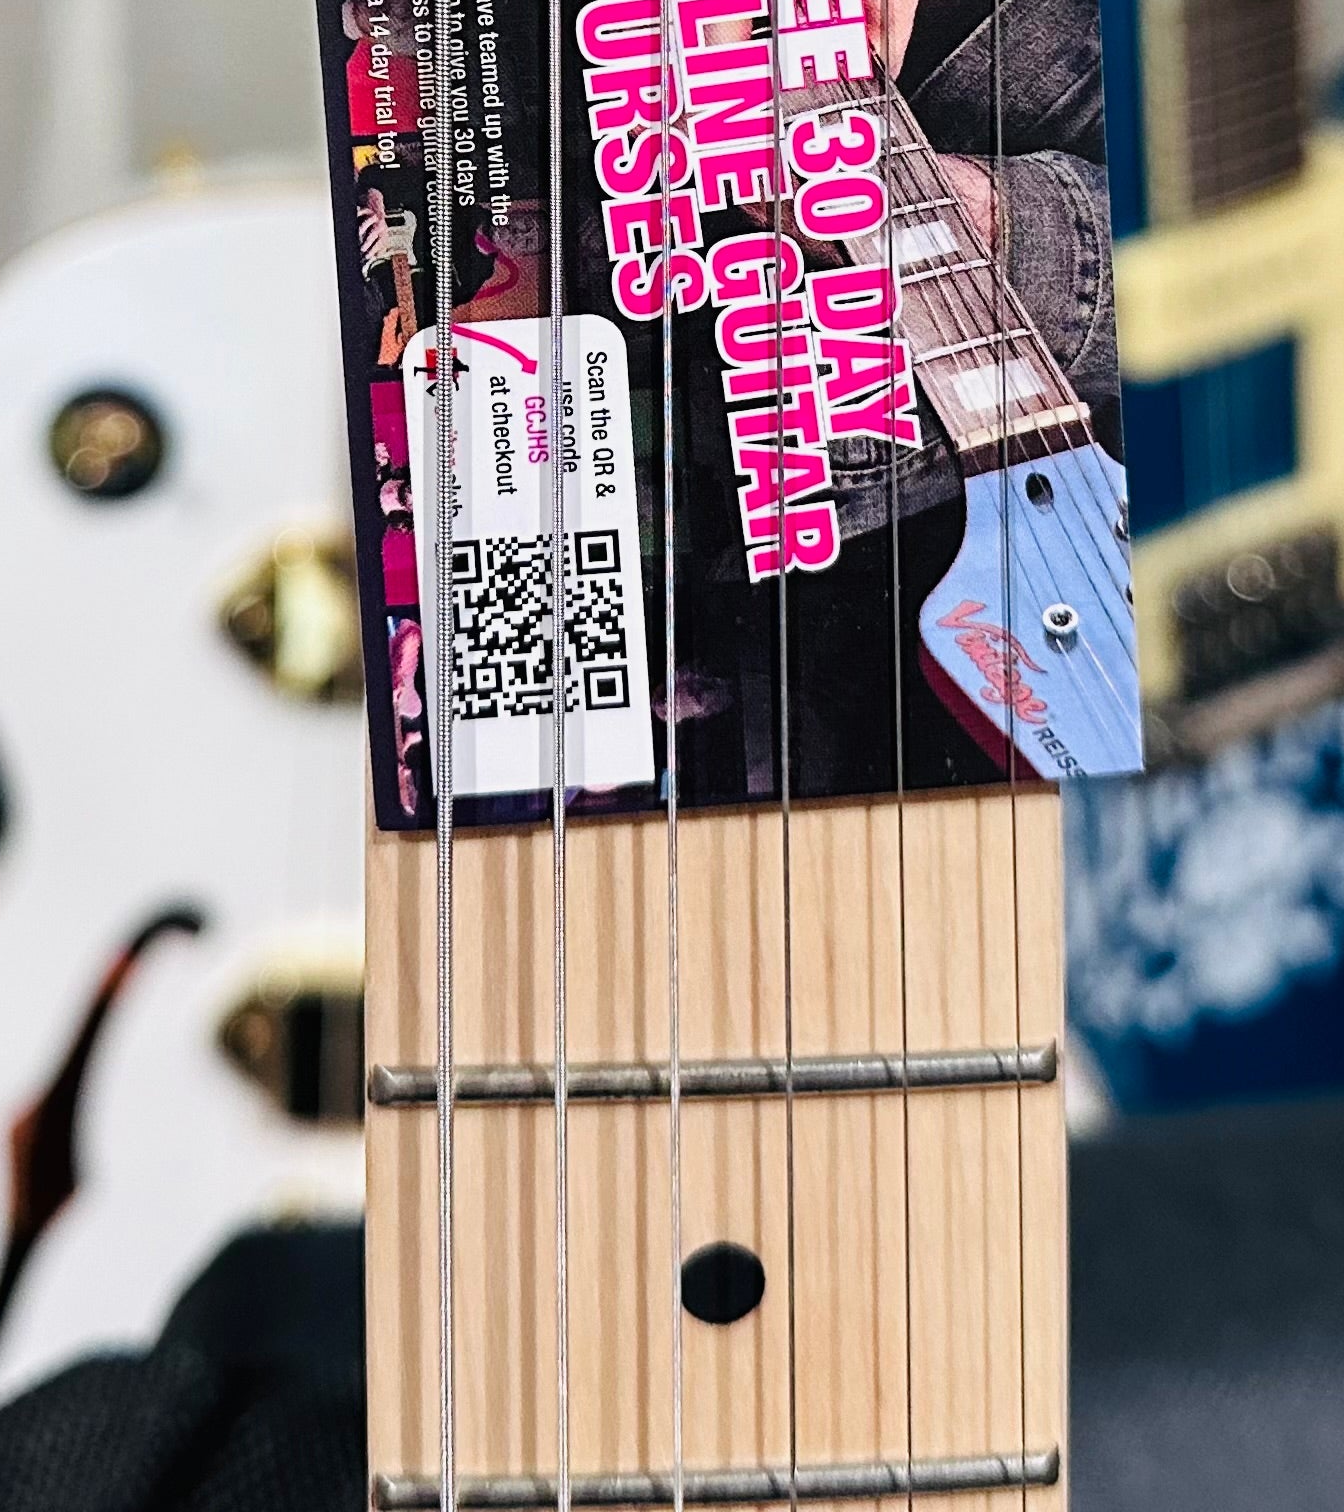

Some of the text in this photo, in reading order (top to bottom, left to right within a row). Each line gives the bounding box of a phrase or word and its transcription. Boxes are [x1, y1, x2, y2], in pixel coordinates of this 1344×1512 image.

[369, 13, 389, 38] 14
[414, 22, 434, 43] to
[447, 12, 465, 31] to
[368, 44, 392, 80] day
[417, 49, 438, 110] online
[447, 39, 469, 80] give
[479, 32, 504, 107] teamed
[374, 85, 397, 125] trial
[449, 86, 471, 122] you
[417, 117, 439, 172] guitar
[454, 128, 475, 153] 30
[481, 114, 502, 139] up
[376, 131, 400, 169] too!
[487, 145, 510, 188] with
[453, 159, 477, 206] days
[787, 109, 886, 242] 30
[491, 194, 511, 226] the
[805, 268, 924, 449] DAY
[559, 381, 581, 473] use code
[587, 351, 616, 498] Scan the QR &
[705, 232, 839, 584] GUITAR
[490, 376, 517, 495] at checkout
[525, 396, 549, 464] GCJHS
